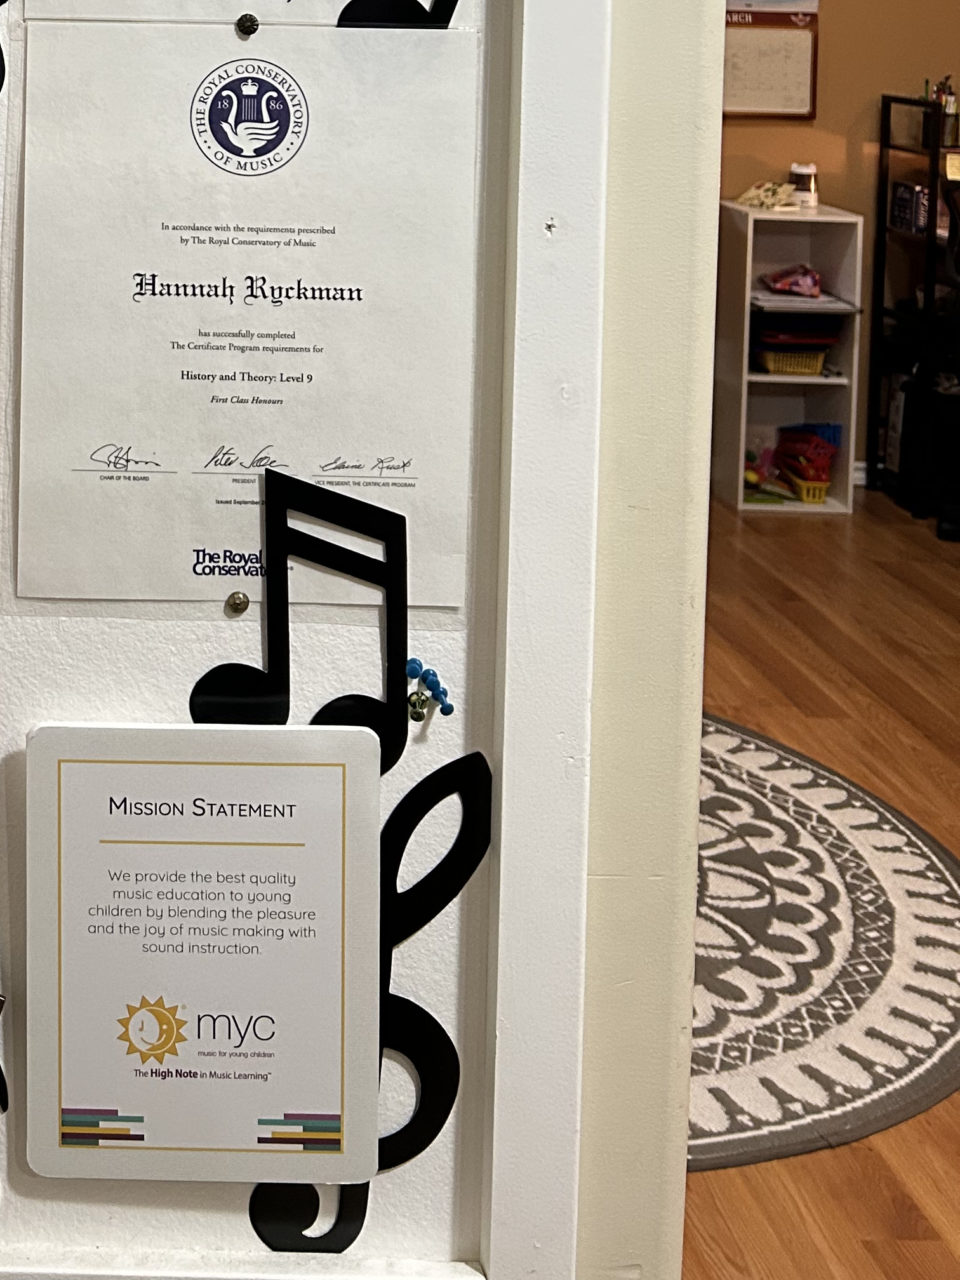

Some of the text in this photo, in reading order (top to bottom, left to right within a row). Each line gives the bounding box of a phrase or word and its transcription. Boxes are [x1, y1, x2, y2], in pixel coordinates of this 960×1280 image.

[132, 272, 363, 308] Hannah Ryckman
[181, 369, 313, 385] History and Theory: Level 9
[210, 394, 284, 405] First Class Honours
[192, 548, 263, 568] The Royal
[192, 562, 267, 577] Conservat
[107, 868, 296, 888] We provide the best quality
[112, 887, 292, 906] music education to young
[88, 903, 316, 924] children by blending the pleasure
[87, 920, 317, 941] and the joy of music making with
[142, 940, 260, 956] sound instruction.
[196, 1013, 276, 1049] myc
[197, 1049, 275, 1060] music for young children
[134, 1068, 149, 1078] The
[150, 1067, 174, 1081] High
[175, 1068, 199, 1079] Note
[199, 1070, 208, 1079] in
[209, 1070, 232, 1080] Music
